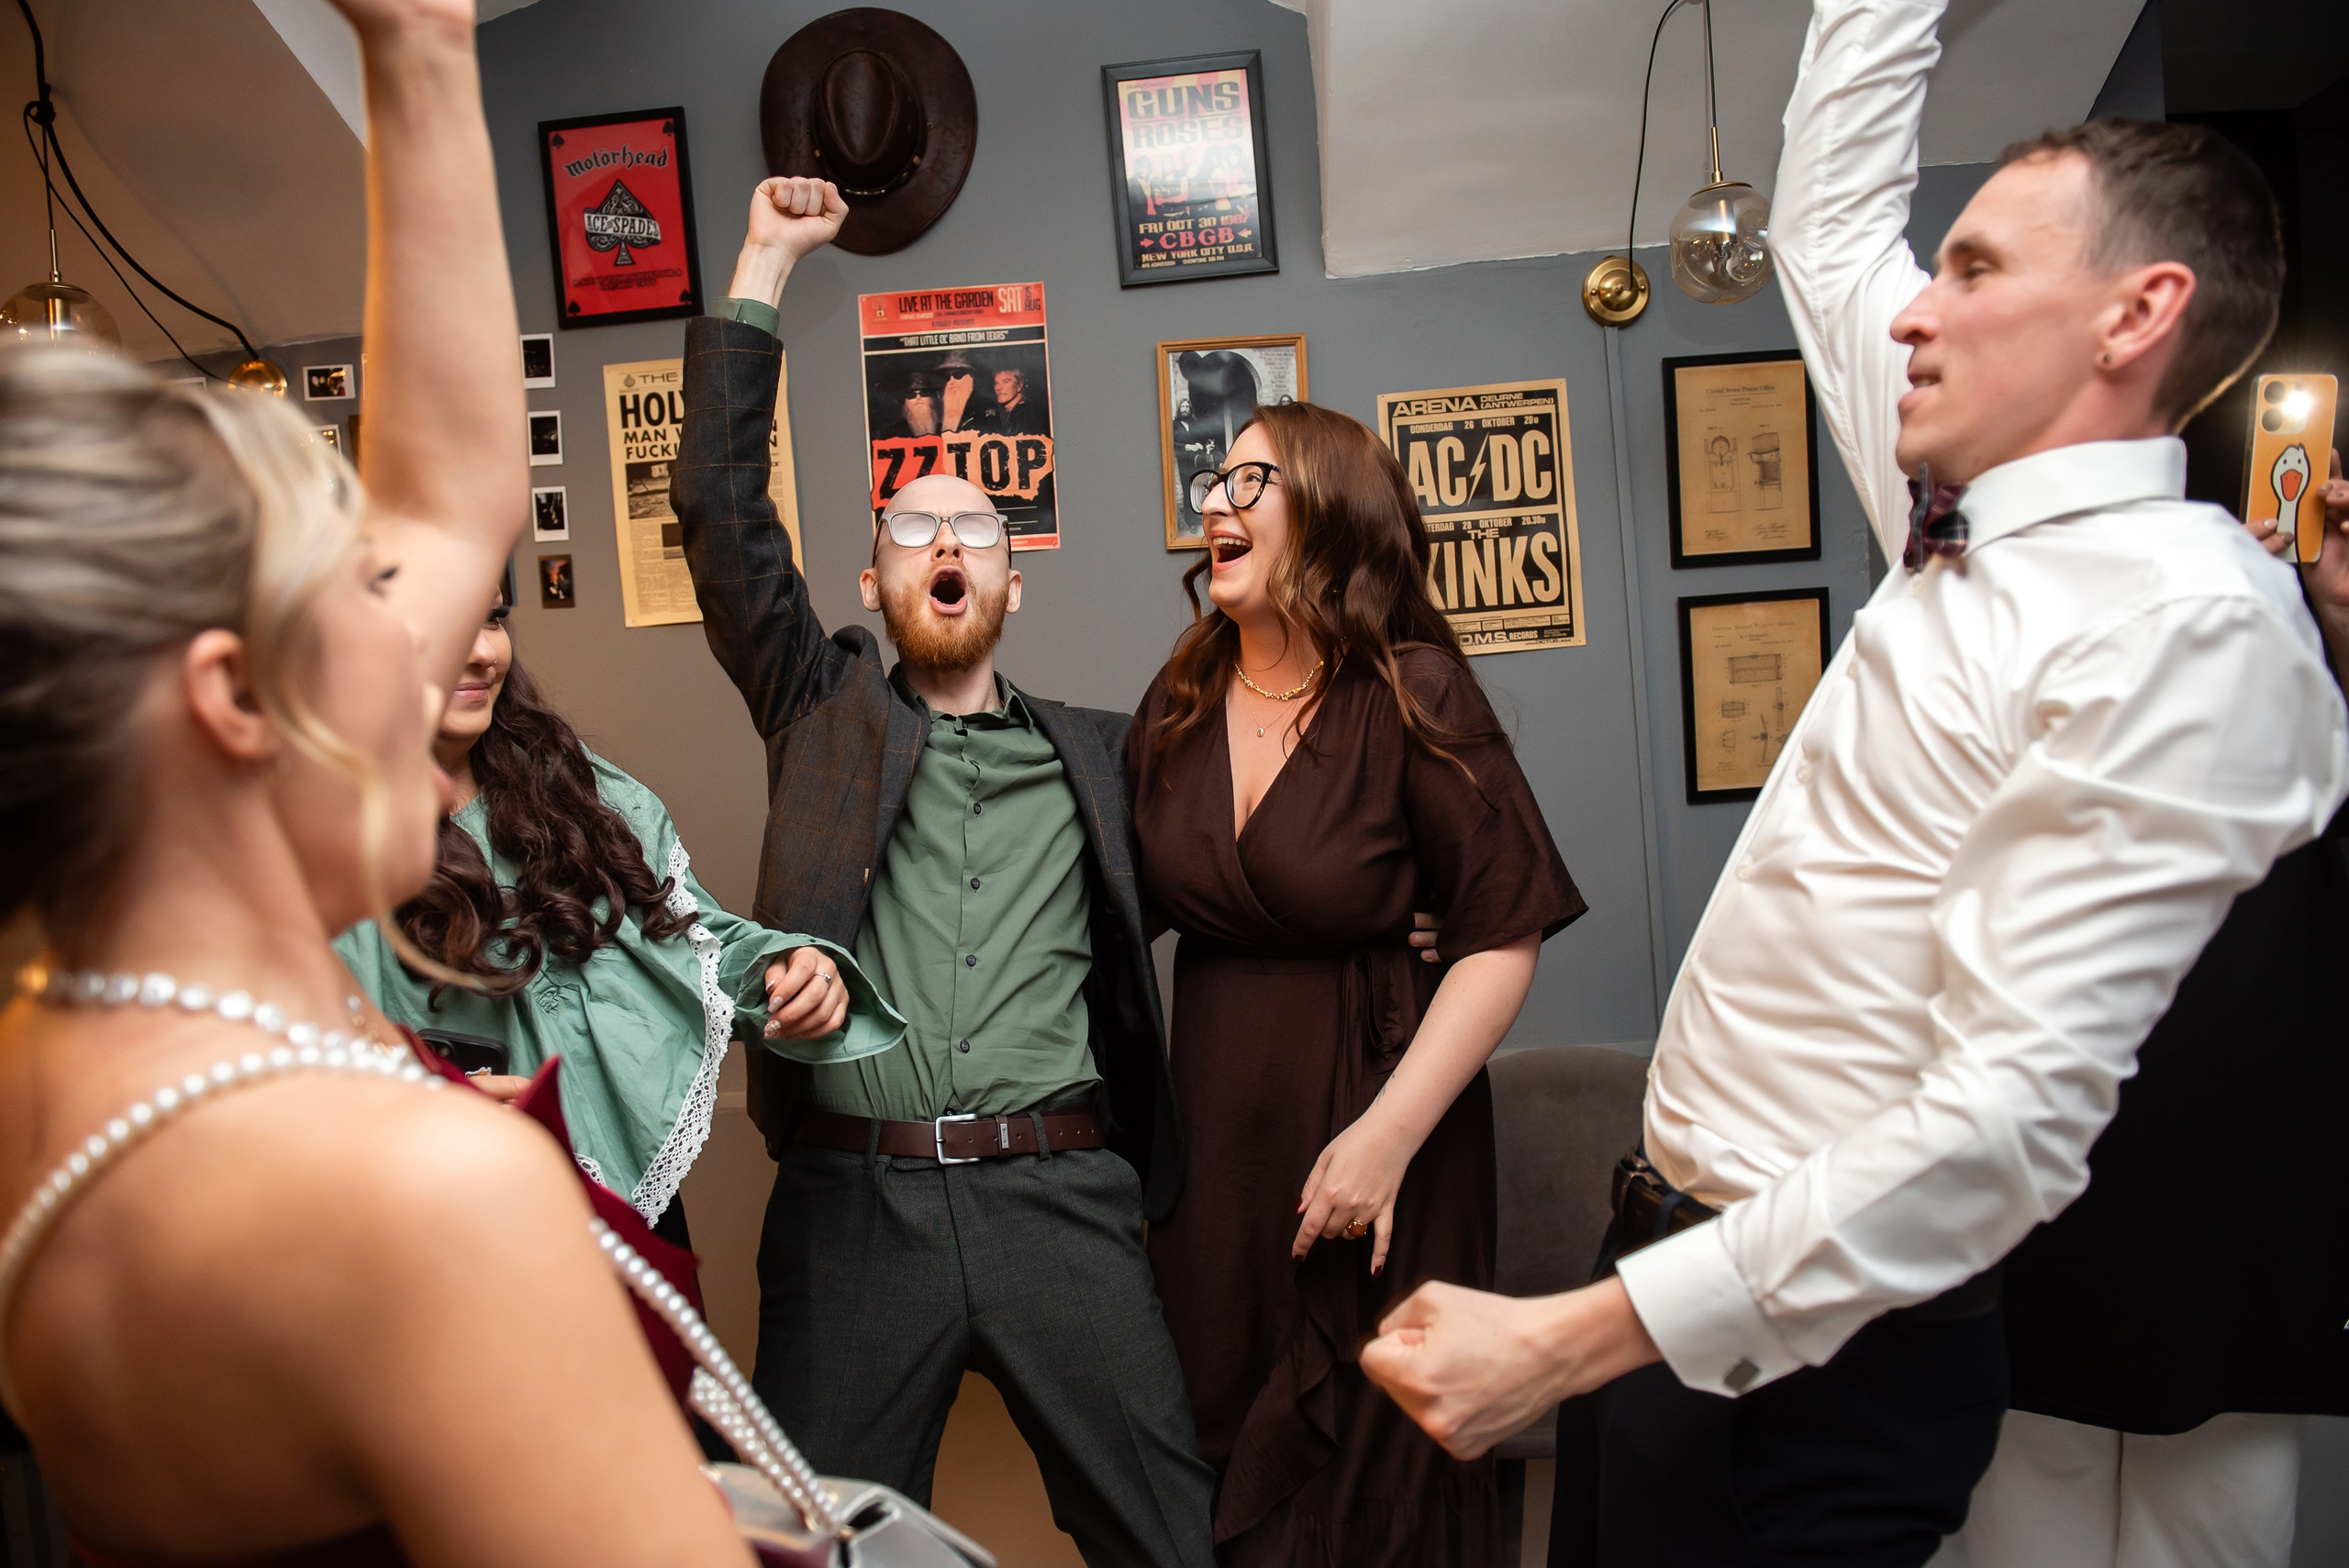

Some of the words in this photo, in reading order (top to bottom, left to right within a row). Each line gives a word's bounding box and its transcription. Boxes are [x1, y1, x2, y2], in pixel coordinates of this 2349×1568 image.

[1127, 81, 1241, 119] GUNS
[1132, 116, 1244, 149] ROSES
[613, 217, 660, 237] SPADES
[1139, 222, 1164, 234] FRI
[1166, 218, 1195, 231] OCT
[1159, 227, 1235, 250] CBGB
[1141, 252, 1167, 263] NEW
[1170, 249, 1197, 259] YORK
[1200, 245, 1225, 256] CITY
[898, 295, 919, 313] LIVE
[920, 295, 932, 311] AT
[934, 293, 952, 310] THE
[954, 291, 995, 309] GARDEN
[997, 286, 1023, 313] SAT
[1025, 298, 1041, 311] AUG
[919, 334, 939, 346] LITTLE
[949, 332, 966, 344] BAND
[967, 331, 985, 342] FROM
[638, 372, 678, 384] THE
[1392, 396, 1478, 417] ARENA
[1480, 392, 1524, 403] DEURNE
[1410, 422, 1453, 434] DONDERDAG
[1464, 420, 1475, 429] 26
[1482, 416, 1516, 428] OKTOBER
[624, 428, 667, 444] MAN
[626, 443, 678, 460] FUCKI
[877, 445, 939, 500] ZZ
[947, 439, 1047, 492] TOP
[1426, 522, 1454, 533] TERDAG
[1462, 520, 1473, 530] 28
[1479, 517, 1512, 529] OKTOBER
[1467, 528, 1500, 539] THE
[1426, 531, 1562, 611] KINKS
[1509, 630, 1539, 640] RECORDS
